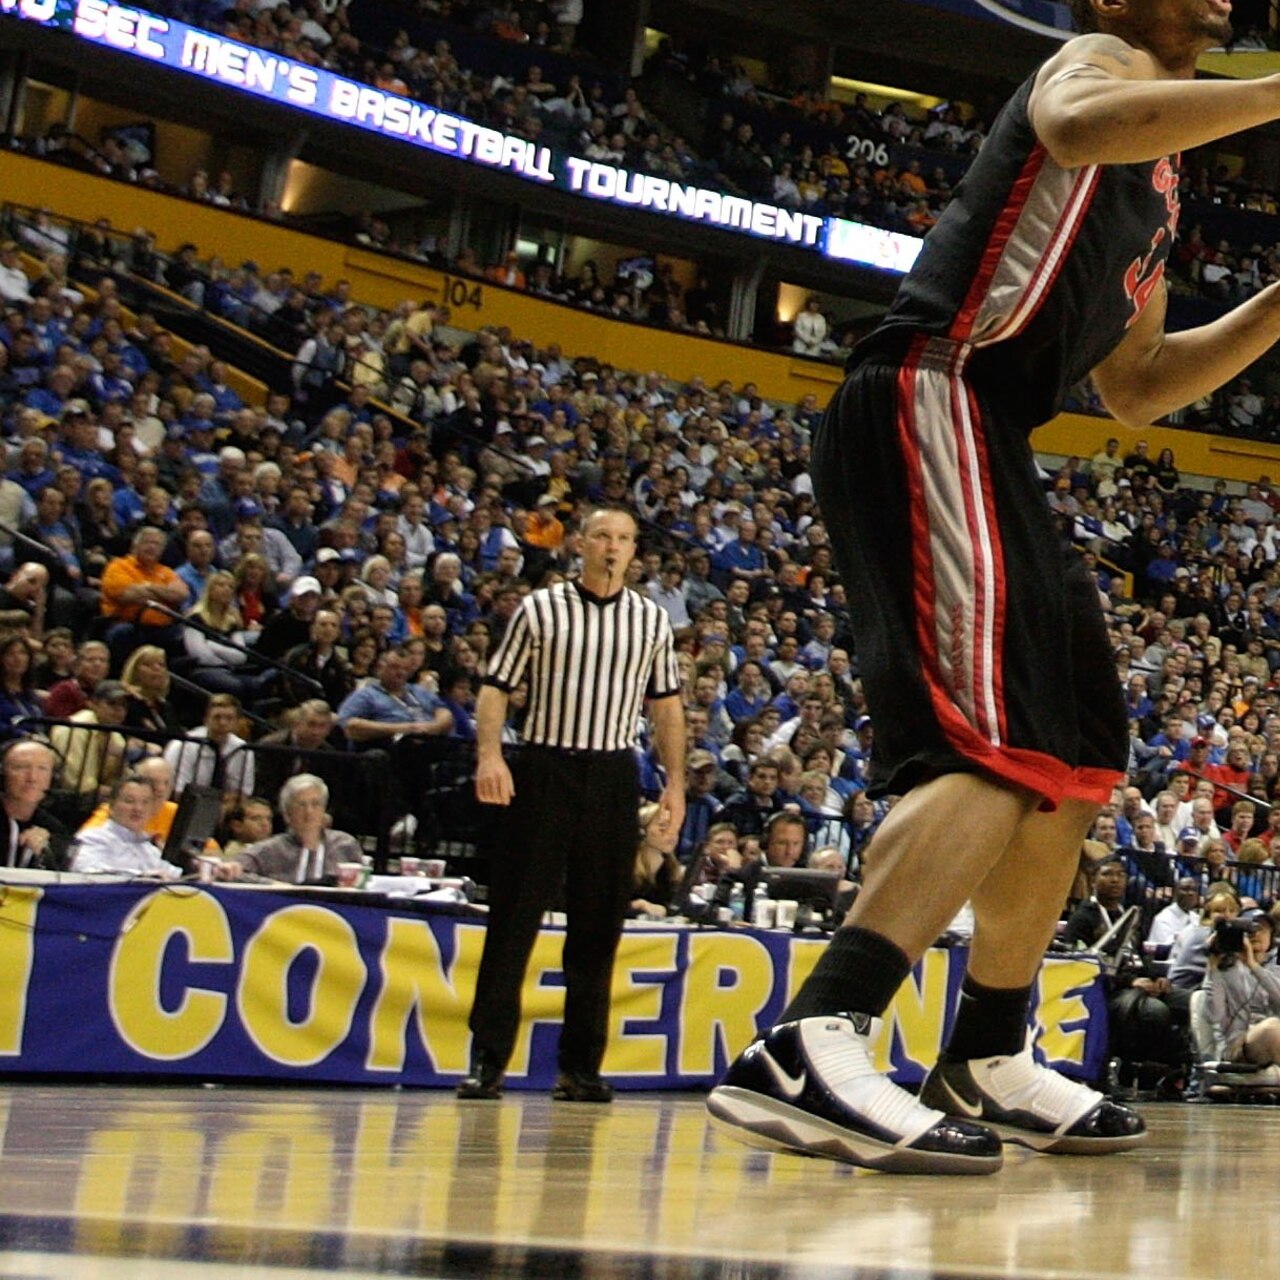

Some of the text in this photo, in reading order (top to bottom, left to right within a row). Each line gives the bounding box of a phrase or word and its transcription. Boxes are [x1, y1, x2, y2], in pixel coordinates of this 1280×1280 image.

[181, 29, 319, 105] MEN'S
[329, 78, 556, 182] BASKETBALL
[566, 155, 824, 246] TOURNAMENT
[846, 134, 890, 167] 206
[443, 276, 484, 311] 104
[109, 887, 1103, 1078] CONFERNE
